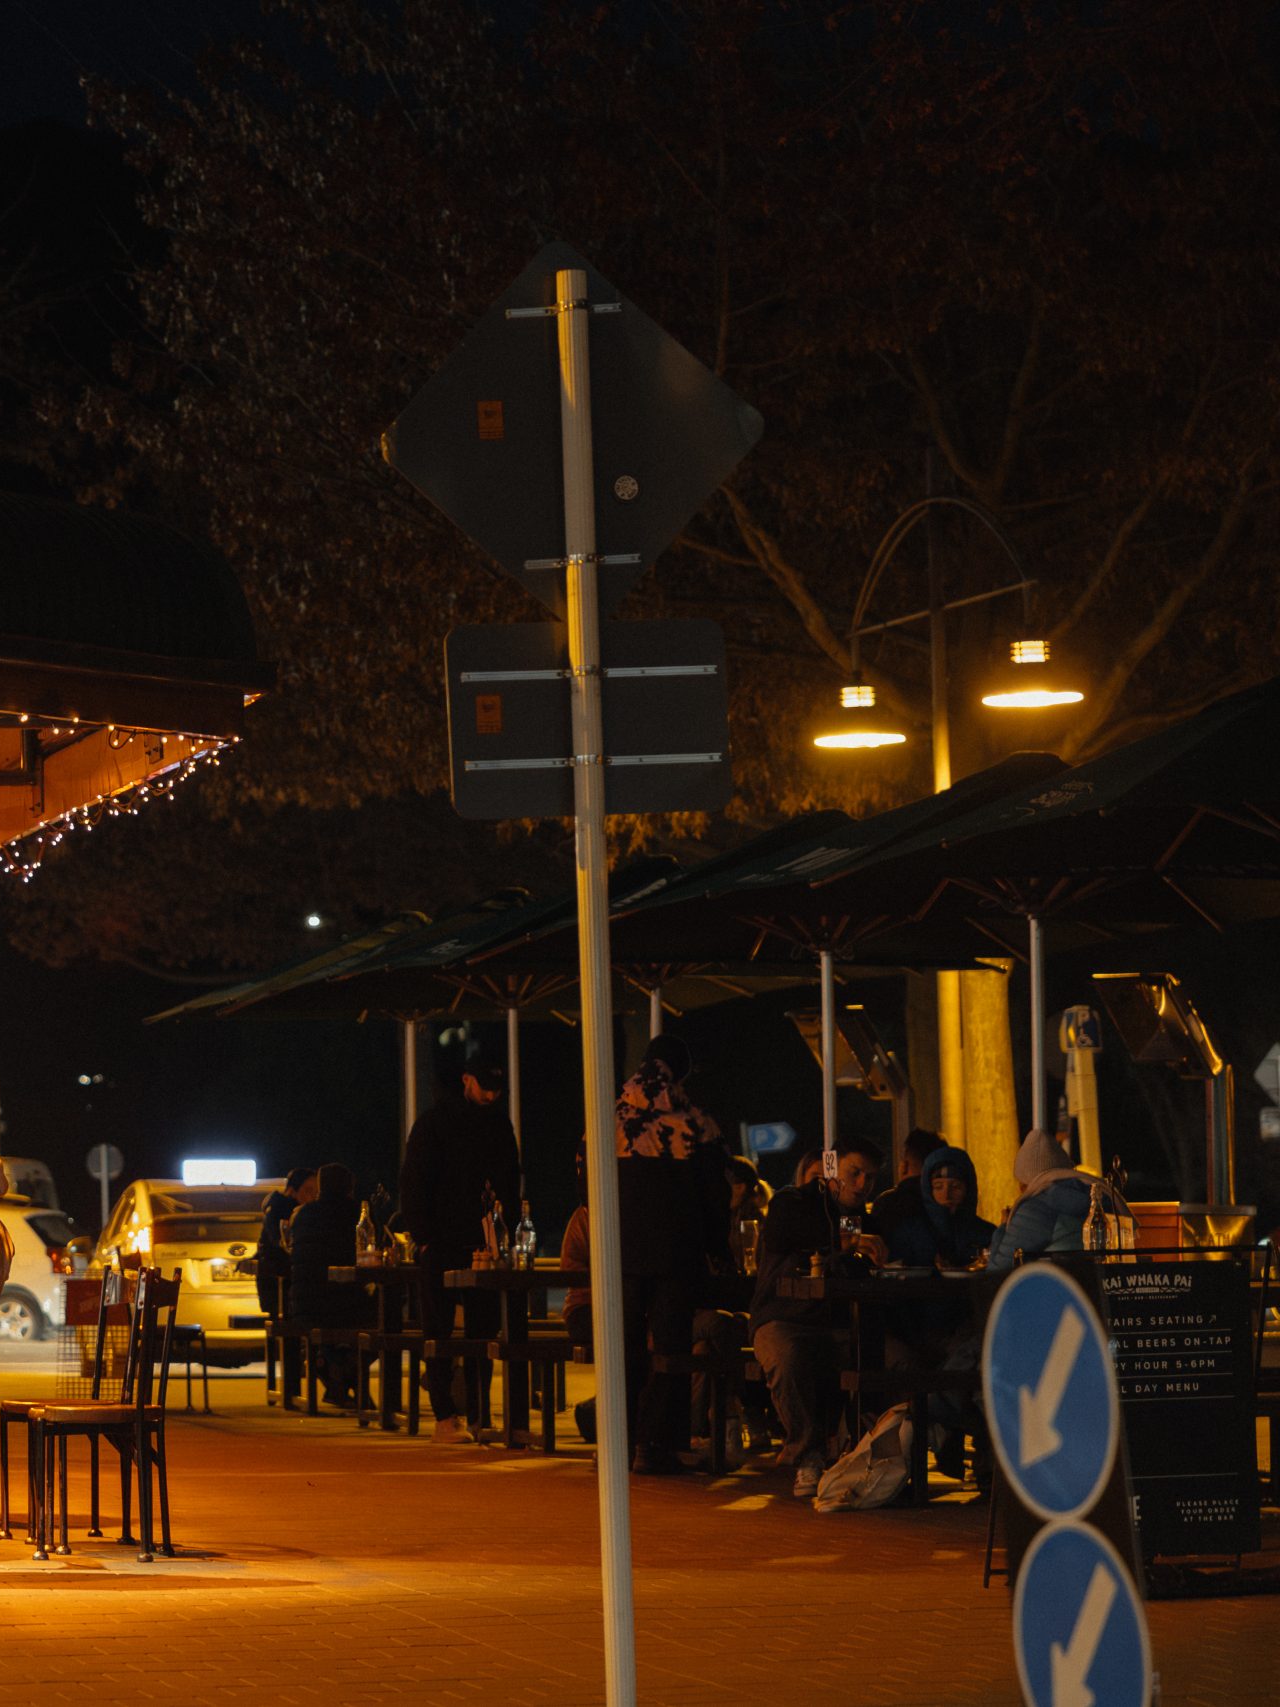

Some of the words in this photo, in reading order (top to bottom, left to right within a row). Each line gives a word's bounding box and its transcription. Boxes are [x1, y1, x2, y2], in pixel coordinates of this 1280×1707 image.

[825, 1153, 835, 1171] 92
[1126, 1273, 1170, 1287] WHAKA
[1106, 1316, 1142, 1327] TAIRS
[1150, 1315, 1204, 1326] SEATING
[1136, 1338, 1177, 1349] BEERS
[1183, 1336, 1232, 1347] ON-TAP
[1134, 1360, 1169, 1371] HOUR
[1176, 1359, 1216, 1369] 5-6PM
[1135, 1383, 1158, 1394] DAY
[1166, 1382, 1200, 1393] MENU
